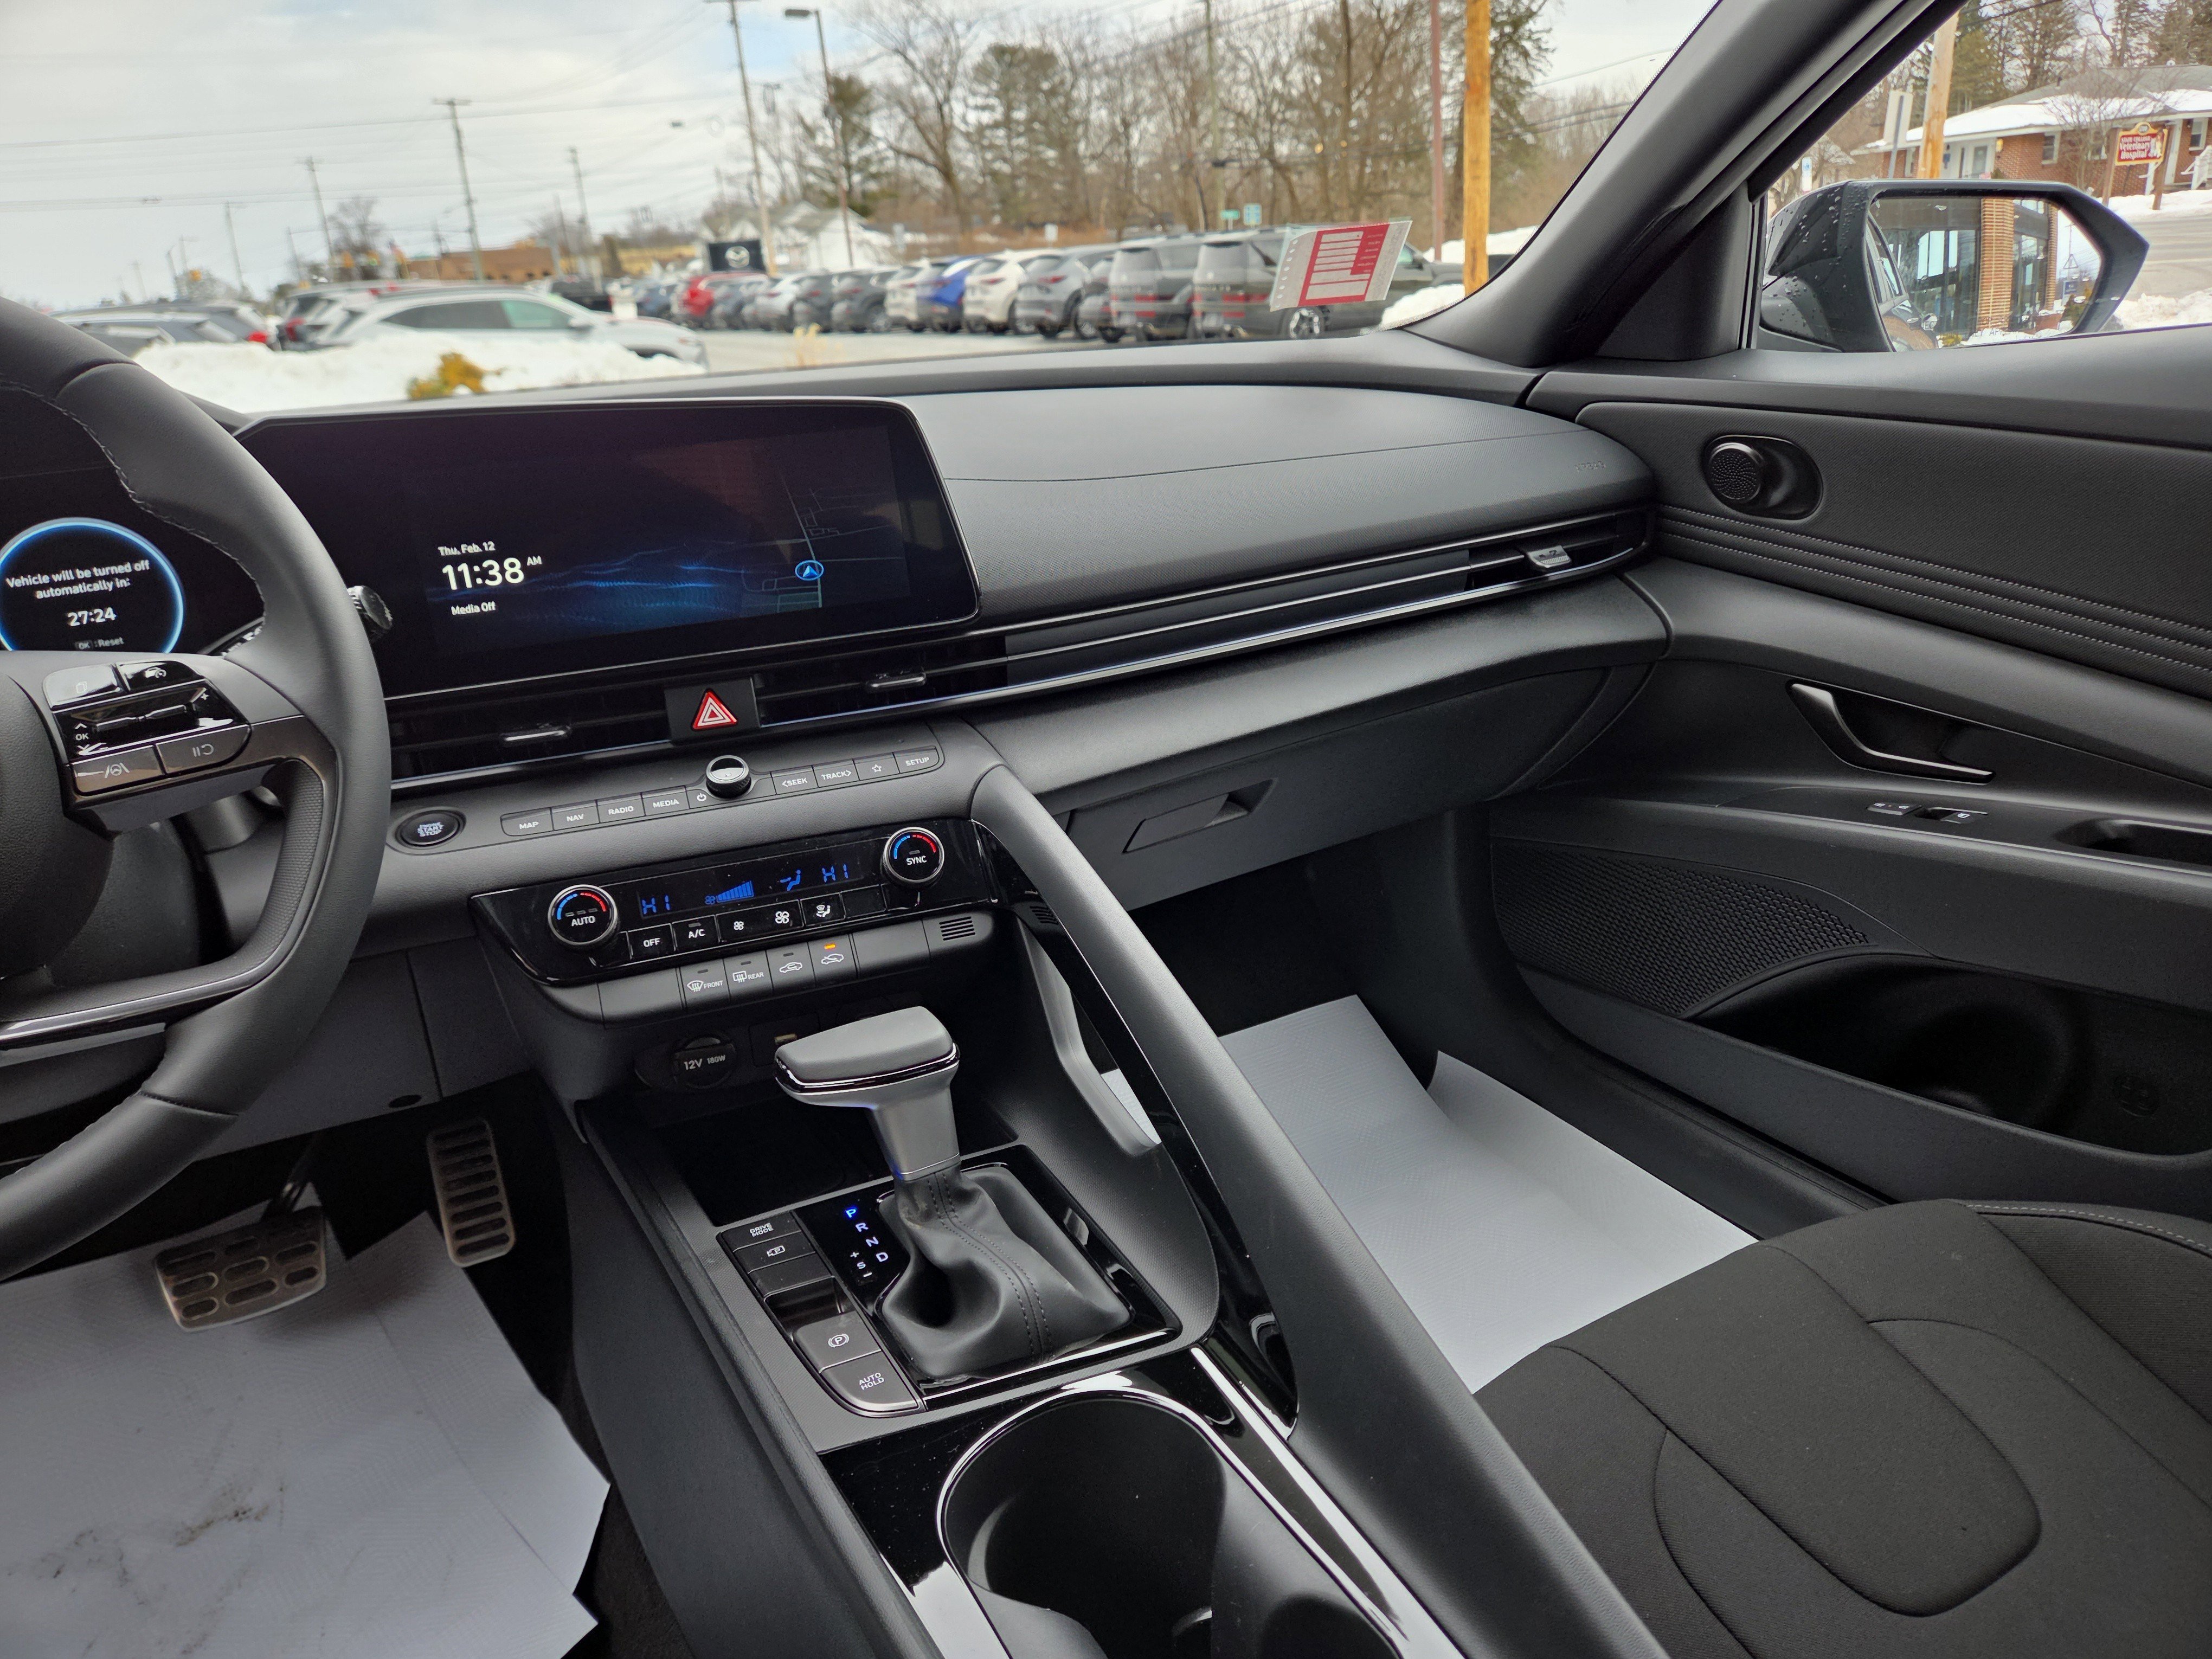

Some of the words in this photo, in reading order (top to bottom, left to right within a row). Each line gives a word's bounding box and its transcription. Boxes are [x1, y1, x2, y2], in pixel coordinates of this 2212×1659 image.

[483, 541, 496, 551] 12
[6, 574, 50, 588] Vehicle
[52, 569, 75, 582] will
[76, 568, 92, 579] be
[93, 562, 132, 577] turned
[134, 560, 150, 571] off
[442, 557, 524, 590] 11:38
[527, 555, 542, 566] AM
[36, 579, 113, 599] automatically
[115, 577, 131, 588] in:
[451, 603, 480, 615] Media
[481, 601, 496, 612] Off
[68, 607, 117, 626] 27:24
[78, 641, 91, 650] OK
[75, 733, 89, 741] OK
[905, 757, 929, 767] SETUP
[653, 799, 679, 808] MEDIA
[608, 806, 634, 815] RADIO
[566, 814, 584, 822] NAV
[417, 825, 444, 833] START
[519, 821, 539, 830] MAP
[906, 855, 927, 865] SYNC
[822, 864, 849, 883] HI
[642, 895, 671, 915] HI
[571, 915, 595, 927] AUTO
[688, 929, 705, 938] A/C
[643, 937, 661, 947] OFF
[748, 972, 764, 980] REAR
[703, 980, 723, 988] FRONT
[684, 1058, 703, 1071] 12V
[707, 1054, 725, 1064] 180W
[846, 1208, 856, 1218] P
[749, 1223, 771, 1233] DRIVE
[751, 1227, 774, 1237] MODE
[856, 1223, 869, 1232] R
[866, 1236, 878, 1247] N
[876, 1252, 889, 1262] D
[857, 1261, 866, 1269] S
[859, 1372, 882, 1386] AUTO
[860, 1377, 884, 1390] HOLD
